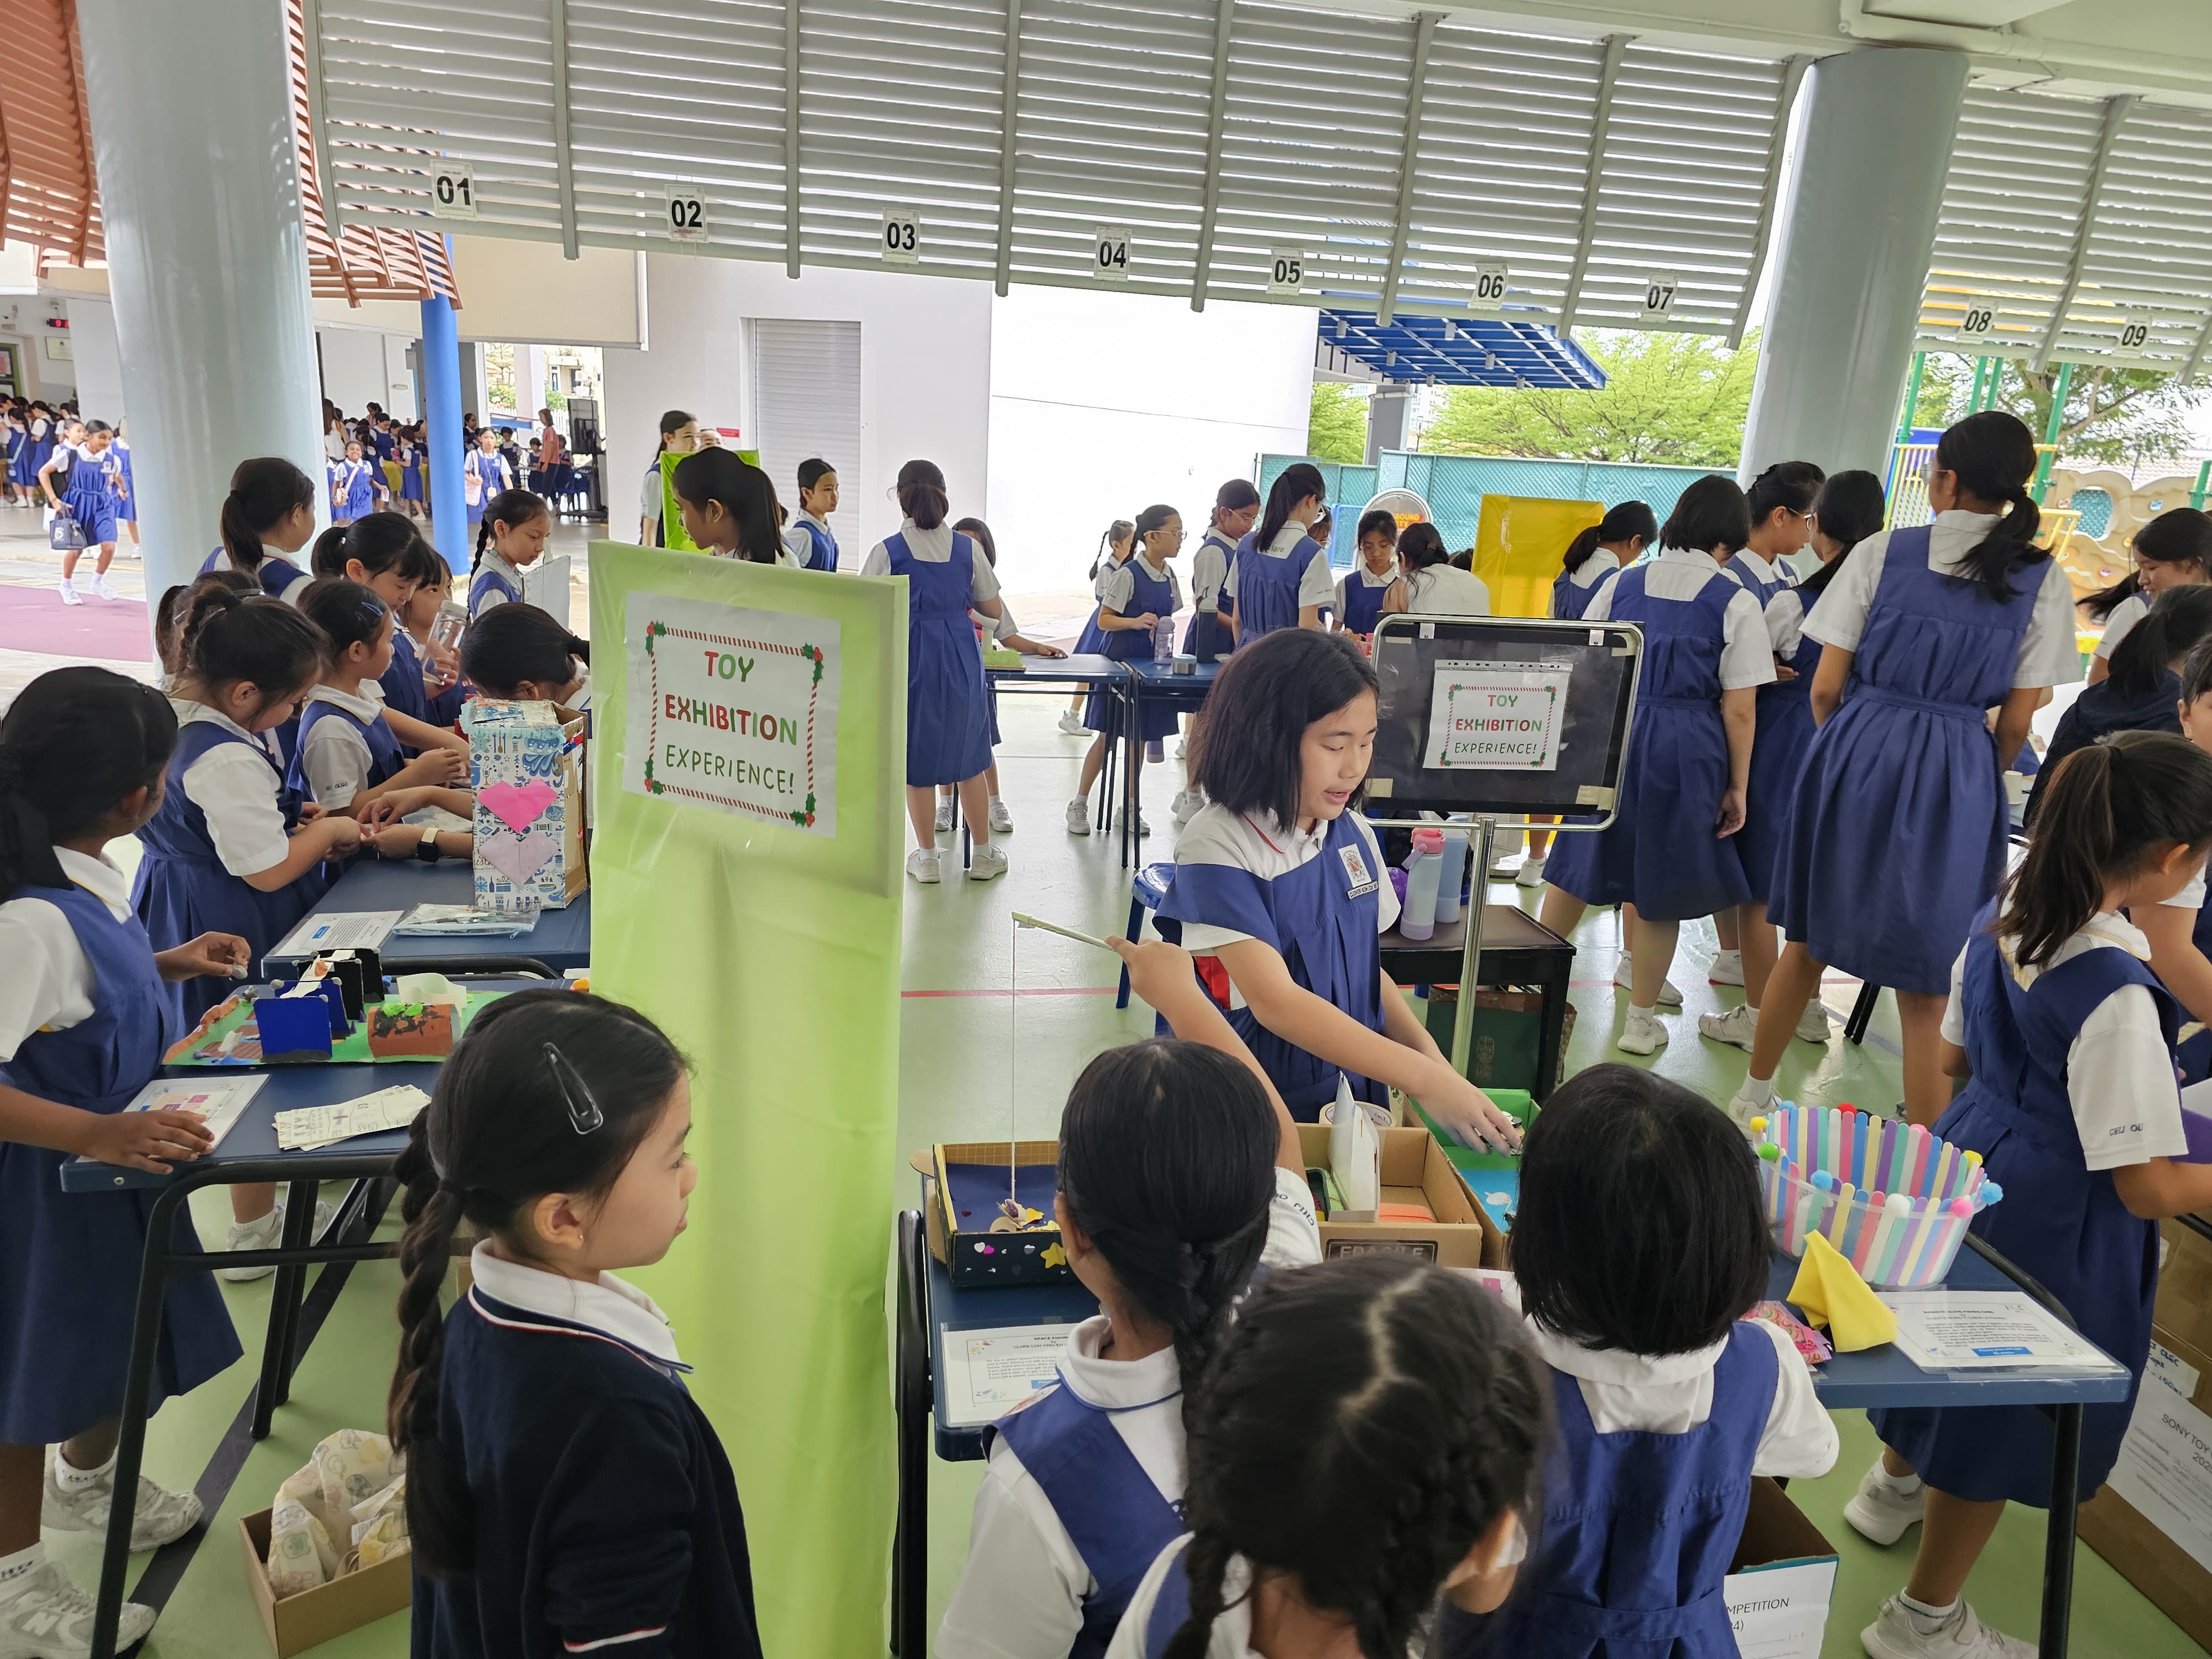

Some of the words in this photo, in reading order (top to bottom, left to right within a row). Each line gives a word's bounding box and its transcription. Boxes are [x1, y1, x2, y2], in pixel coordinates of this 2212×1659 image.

[437, 176, 471, 206] 01
[671, 200, 702, 227] 02
[888, 222, 915, 250] 03
[1100, 241, 1126, 268] 04
[1275, 259, 1301, 284] 05
[1478, 274, 1504, 299] 06
[1647, 285, 1673, 310] 07
[1965, 310, 1992, 332] 08
[2122, 325, 2147, 347] 09
[704, 650, 754, 682] TOY
[1488, 695, 1518, 707] TOY
[665, 694, 797, 745] EXHIBITION
[1455, 719, 1542, 732] EXHIBITION
[1454, 742, 1537, 754] EXPERIENCE!
[666, 744, 794, 795] EXPERIENCE!
[2162, 1413, 2190, 1438] SONY
[2190, 1434, 2210, 1453] TOY
[1727, 1597, 1790, 1615] MPETITION
[1731, 1620, 1744, 1632] 4)
